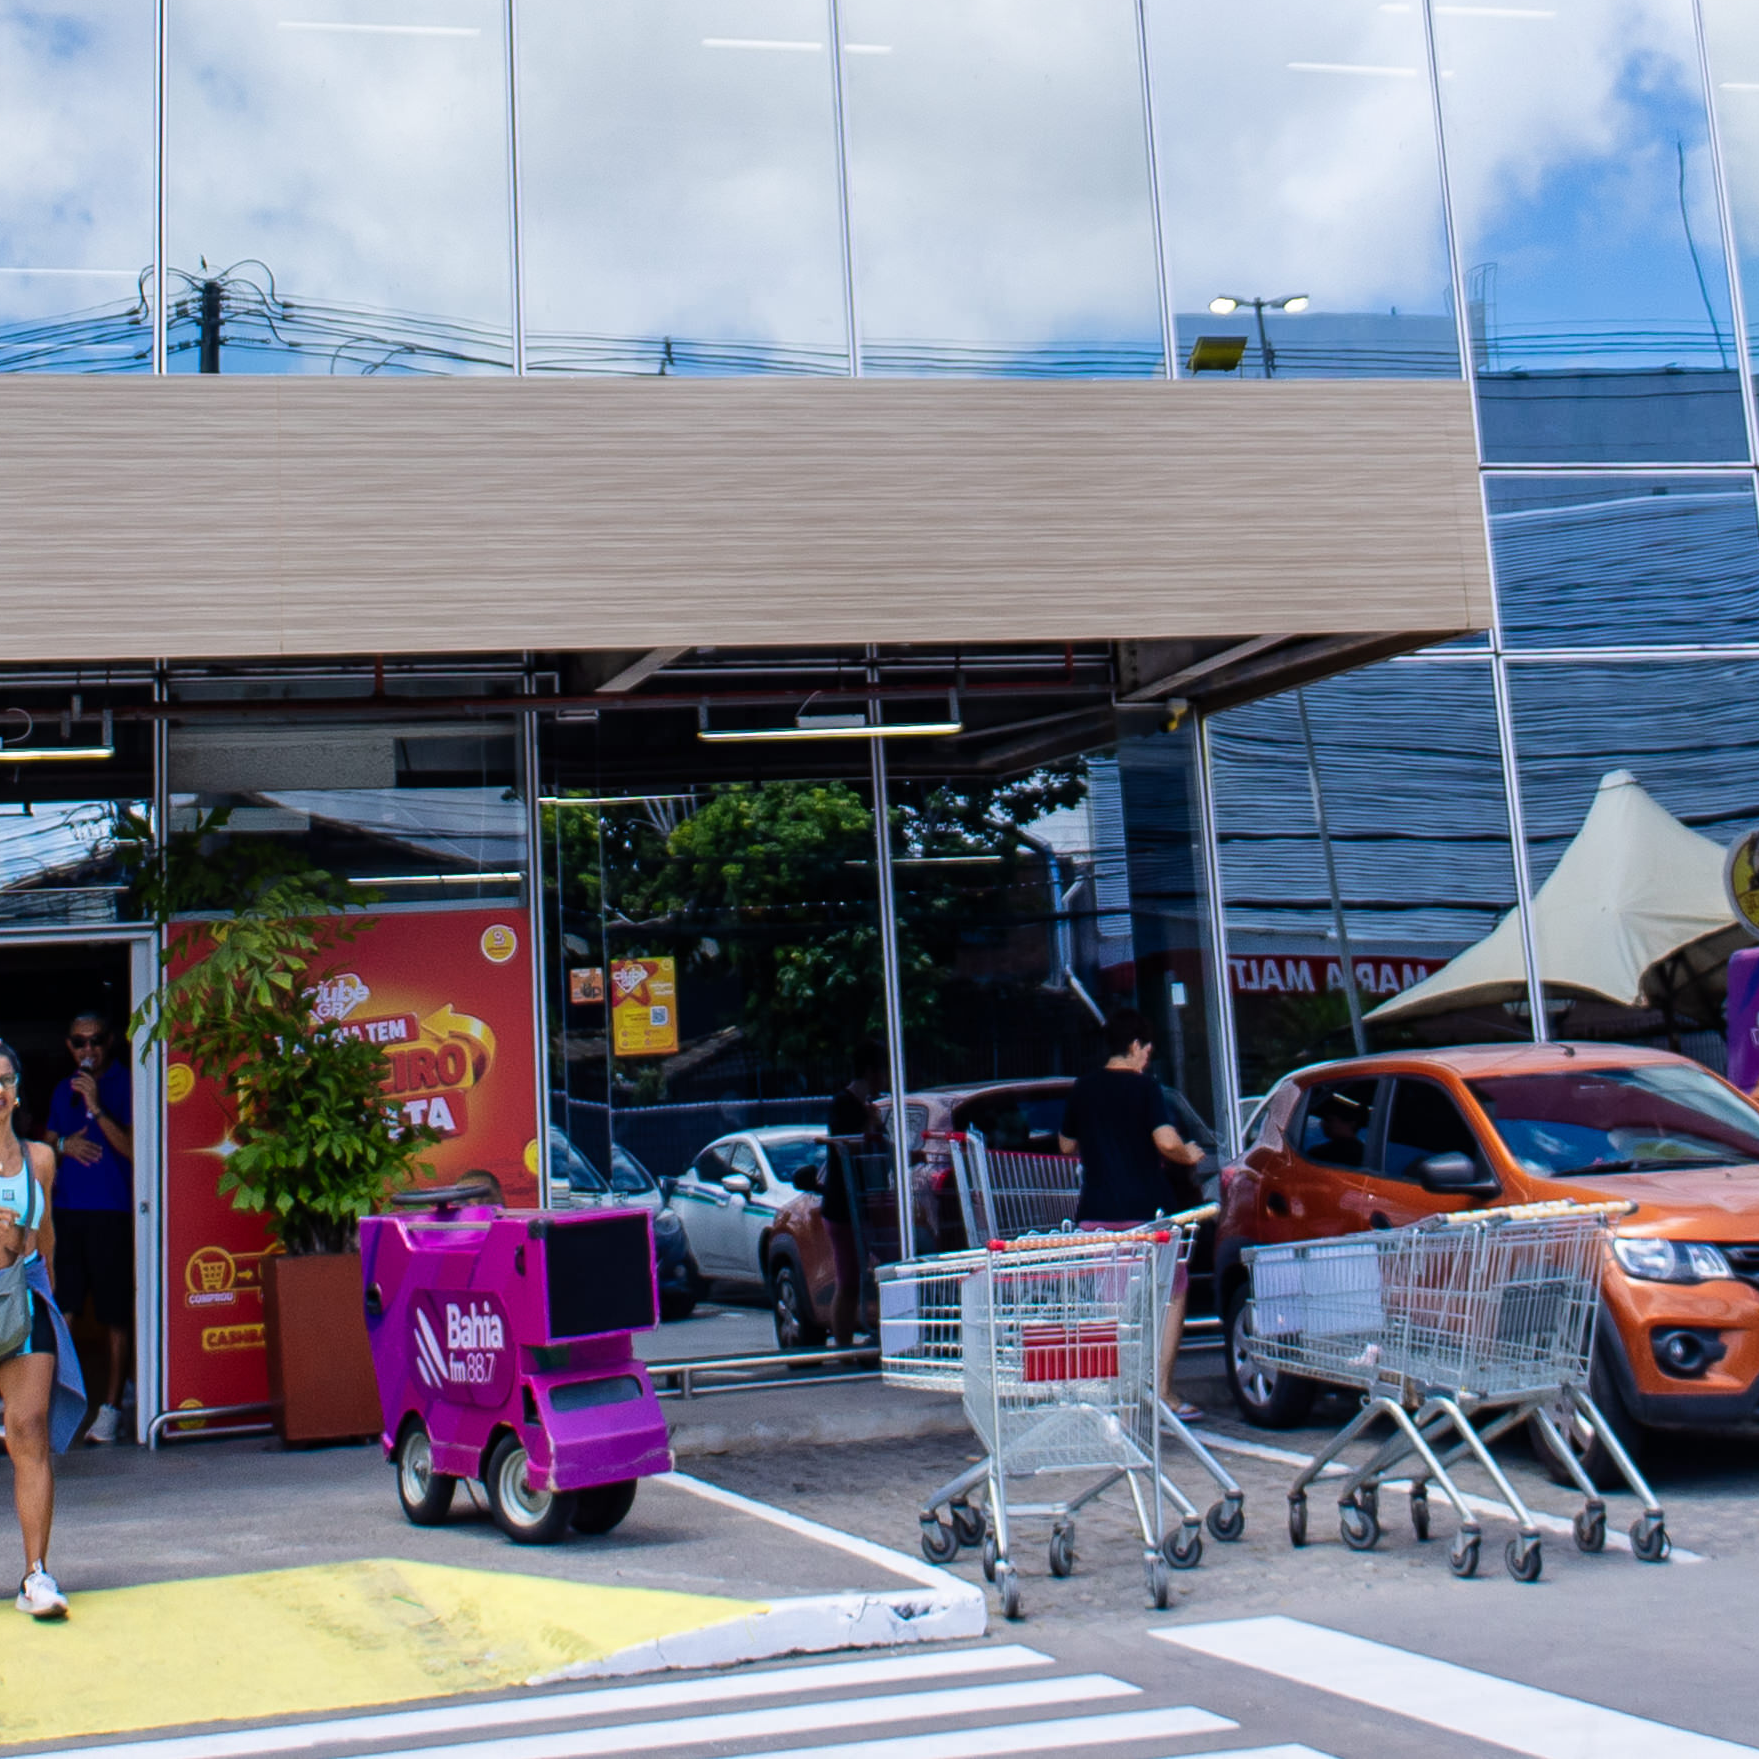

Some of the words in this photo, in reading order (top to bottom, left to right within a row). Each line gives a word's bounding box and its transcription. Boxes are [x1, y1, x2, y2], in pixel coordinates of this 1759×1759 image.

[366, 1019, 407, 1042] TEM
[446, 1300, 505, 1351] Bahia
[466, 1352, 496, 1383] 88.7
